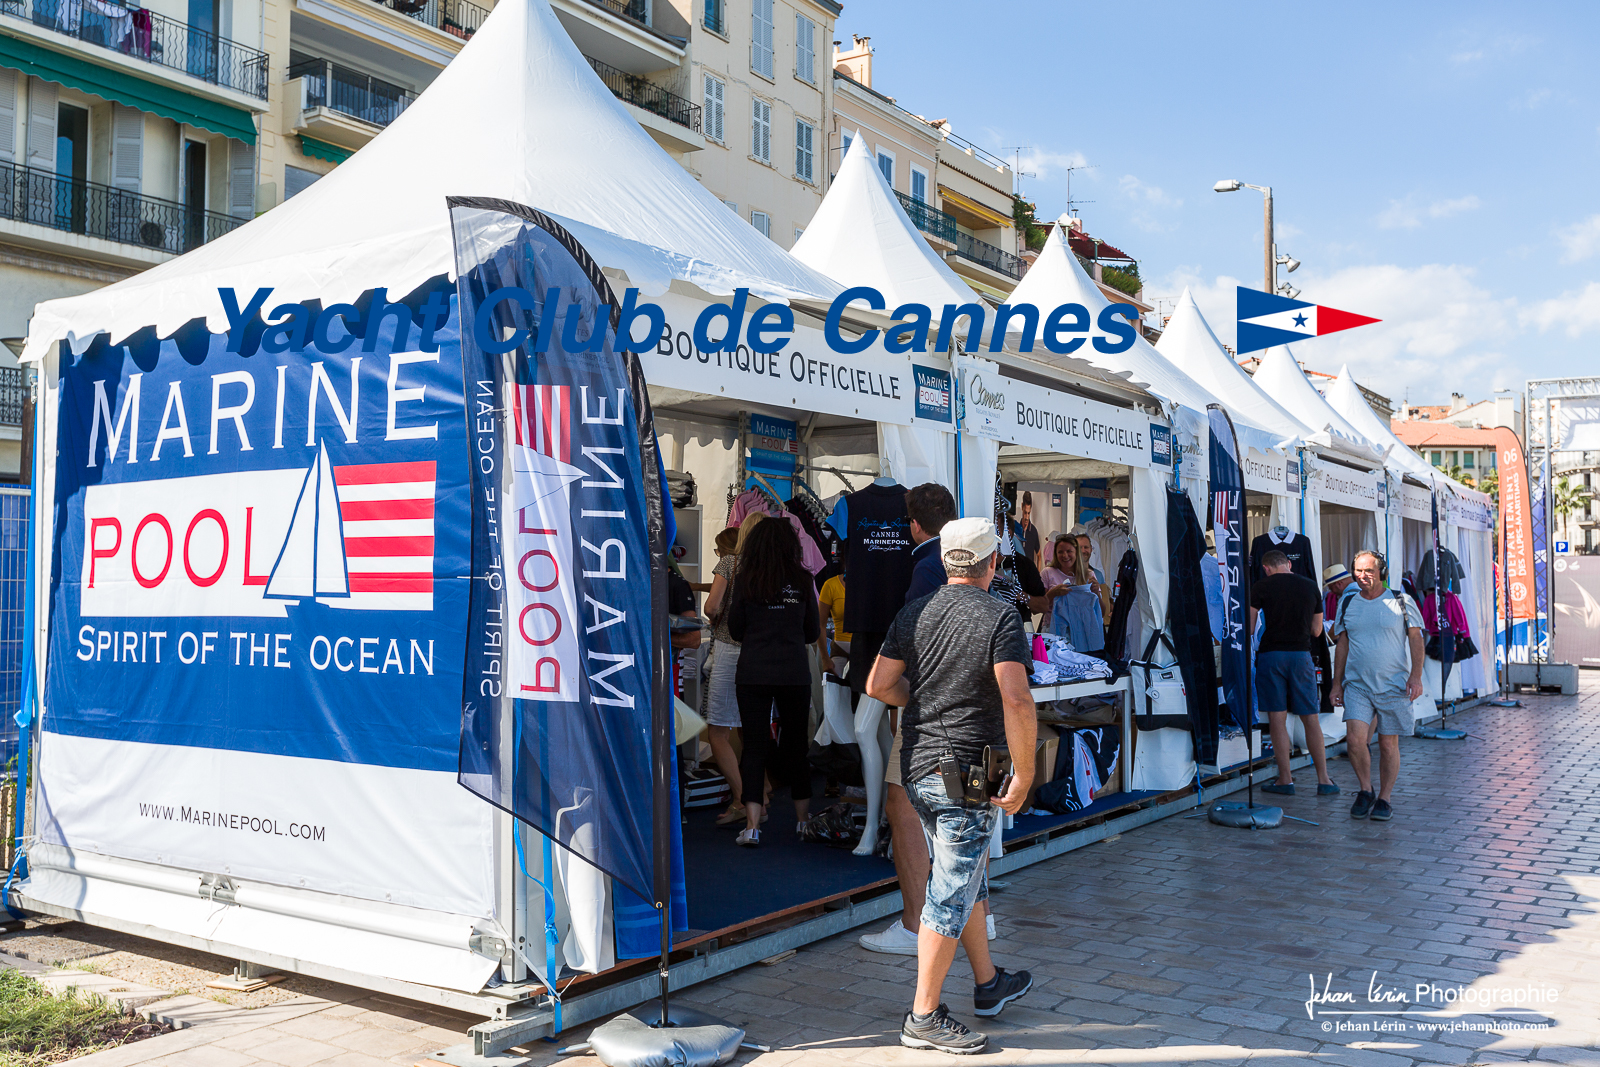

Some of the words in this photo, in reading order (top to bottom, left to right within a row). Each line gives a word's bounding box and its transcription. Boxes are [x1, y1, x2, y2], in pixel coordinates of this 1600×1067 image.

[789, 351, 901, 400] OFFICIELLE
[917, 372, 949, 391] MARINE
[86, 345, 441, 468] MARINE
[756, 421, 793, 440] MARINE
[1016, 401, 1079, 437] BOUTIQUE
[1083, 417, 1144, 451] OFFICIELLE
[1245, 457, 1281, 482] OFFICIELLE
[87, 506, 270, 589] POOL
[863, 538, 910, 546] MARINEPOOL
[1558, 542, 1566, 552] P
[76, 625, 168, 663] SPIRIT
[178, 631, 218, 664] OF
[230, 632, 292, 668] THE
[309, 635, 435, 676] OCEAN
